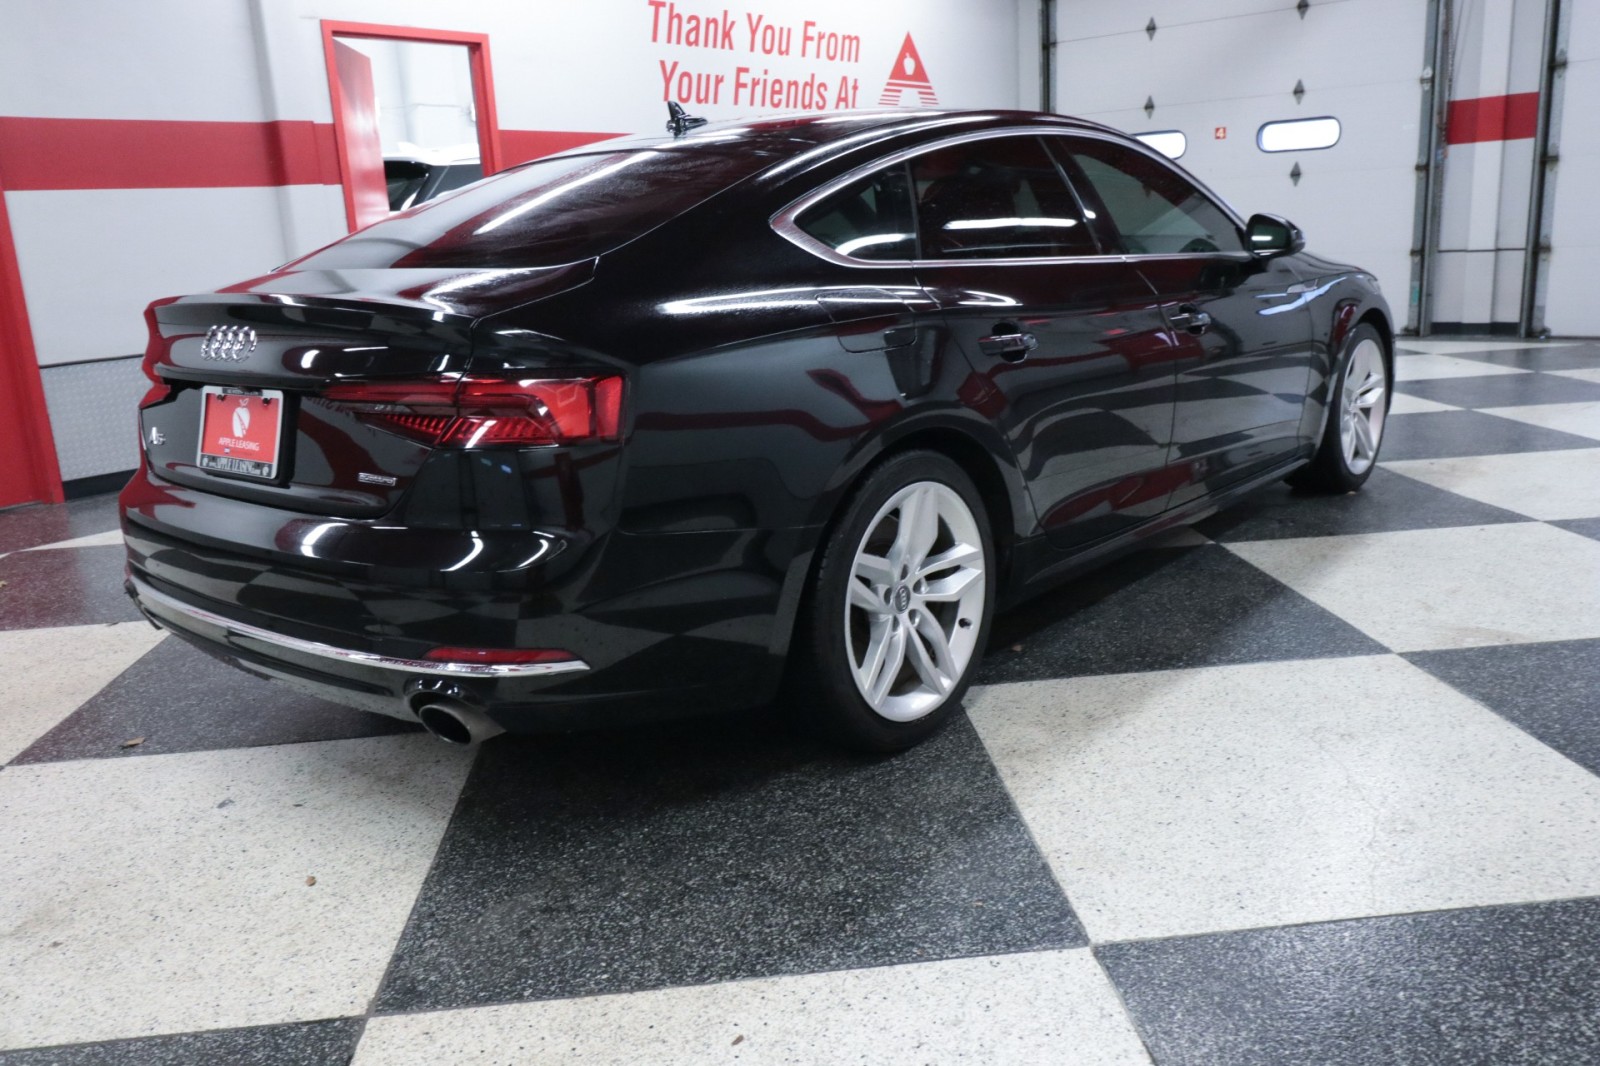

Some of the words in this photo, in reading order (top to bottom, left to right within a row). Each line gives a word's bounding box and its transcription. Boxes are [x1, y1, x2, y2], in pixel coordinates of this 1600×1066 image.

[648, 0, 736, 50] Thank
[746, 13, 792, 56] You
[801, 20, 860, 63] From
[659, 60, 724, 105] Your
[733, 66, 828, 110] Friends
[835, 75, 859, 109] At
[1216, 128, 1225, 139] 4
[218, 437, 236, 448] APPLE
[236, 440, 260, 451] LEASING
